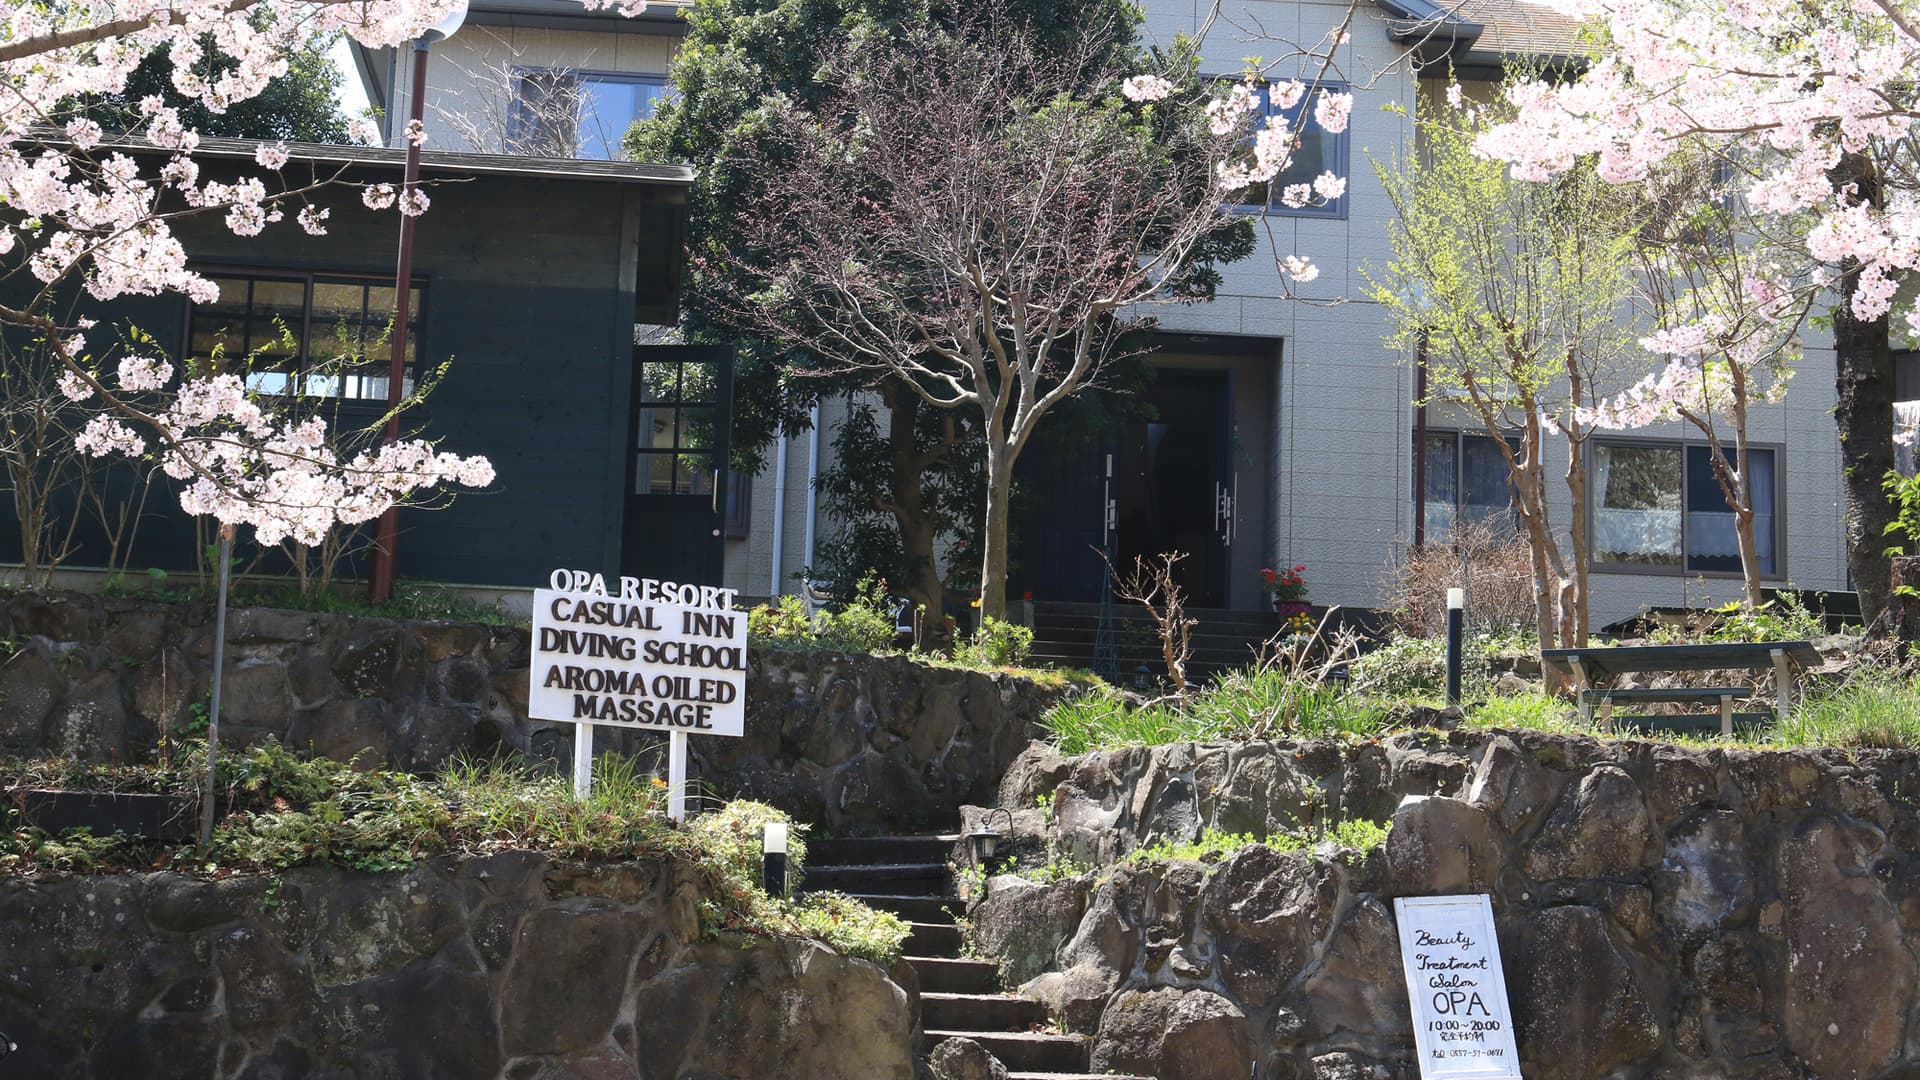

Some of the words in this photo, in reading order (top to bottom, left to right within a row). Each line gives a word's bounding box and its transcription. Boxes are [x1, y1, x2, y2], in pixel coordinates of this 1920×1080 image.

[550, 568, 609, 597] OPA
[619, 576, 739, 612] RESORT
[551, 597, 662, 632] CASUAL
[682, 611, 735, 639] INN
[540, 627, 636, 661] DIVING
[643, 639, 747, 671] SCHOOL
[544, 664, 648, 697] AROMA
[652, 675, 736, 705] OILED
[573, 694, 713, 729] MASSAGE
[1415, 929, 1475, 950] Beauty
[1415, 953, 1488, 971] Treatment
[1429, 973, 1478, 989] Salon
[1433, 991, 1491, 1016] OPA
